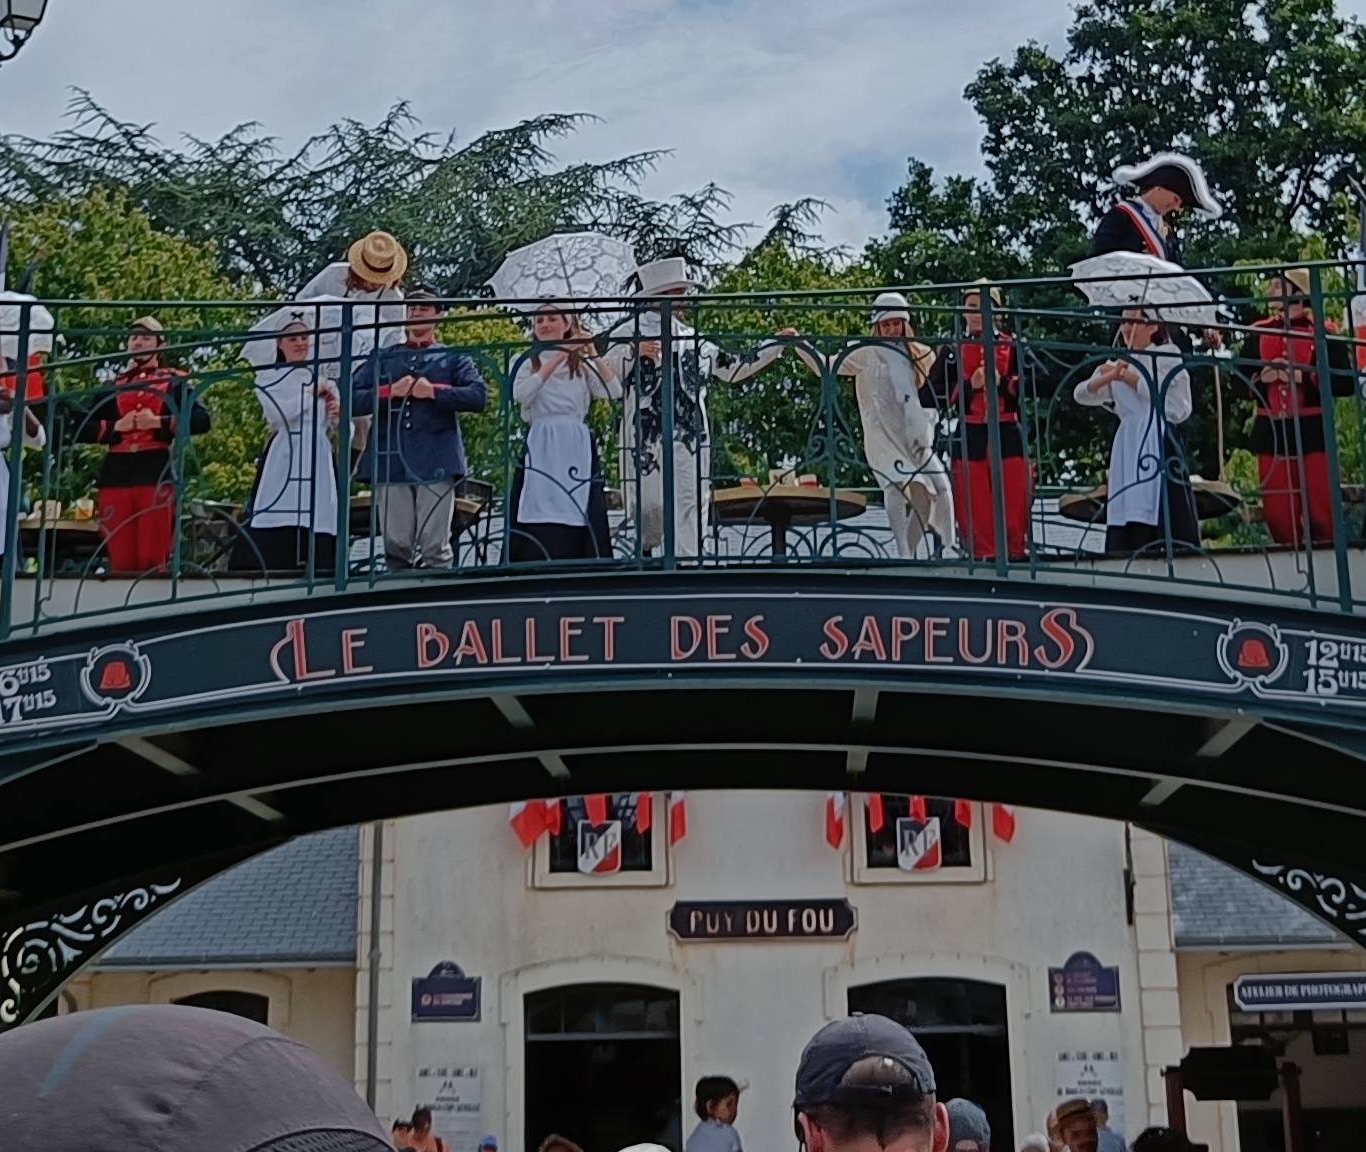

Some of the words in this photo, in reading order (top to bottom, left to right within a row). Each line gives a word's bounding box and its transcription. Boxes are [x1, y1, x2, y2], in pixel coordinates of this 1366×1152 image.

[286, 617, 373, 680] LE
[416, 616, 625, 668] BALLET
[669, 614, 769, 660] DES
[819, 606, 1080, 669] SAPEURS
[690, 910, 733, 934] PUY
[746, 909, 778, 934] DU
[788, 908, 834, 933] FOU
